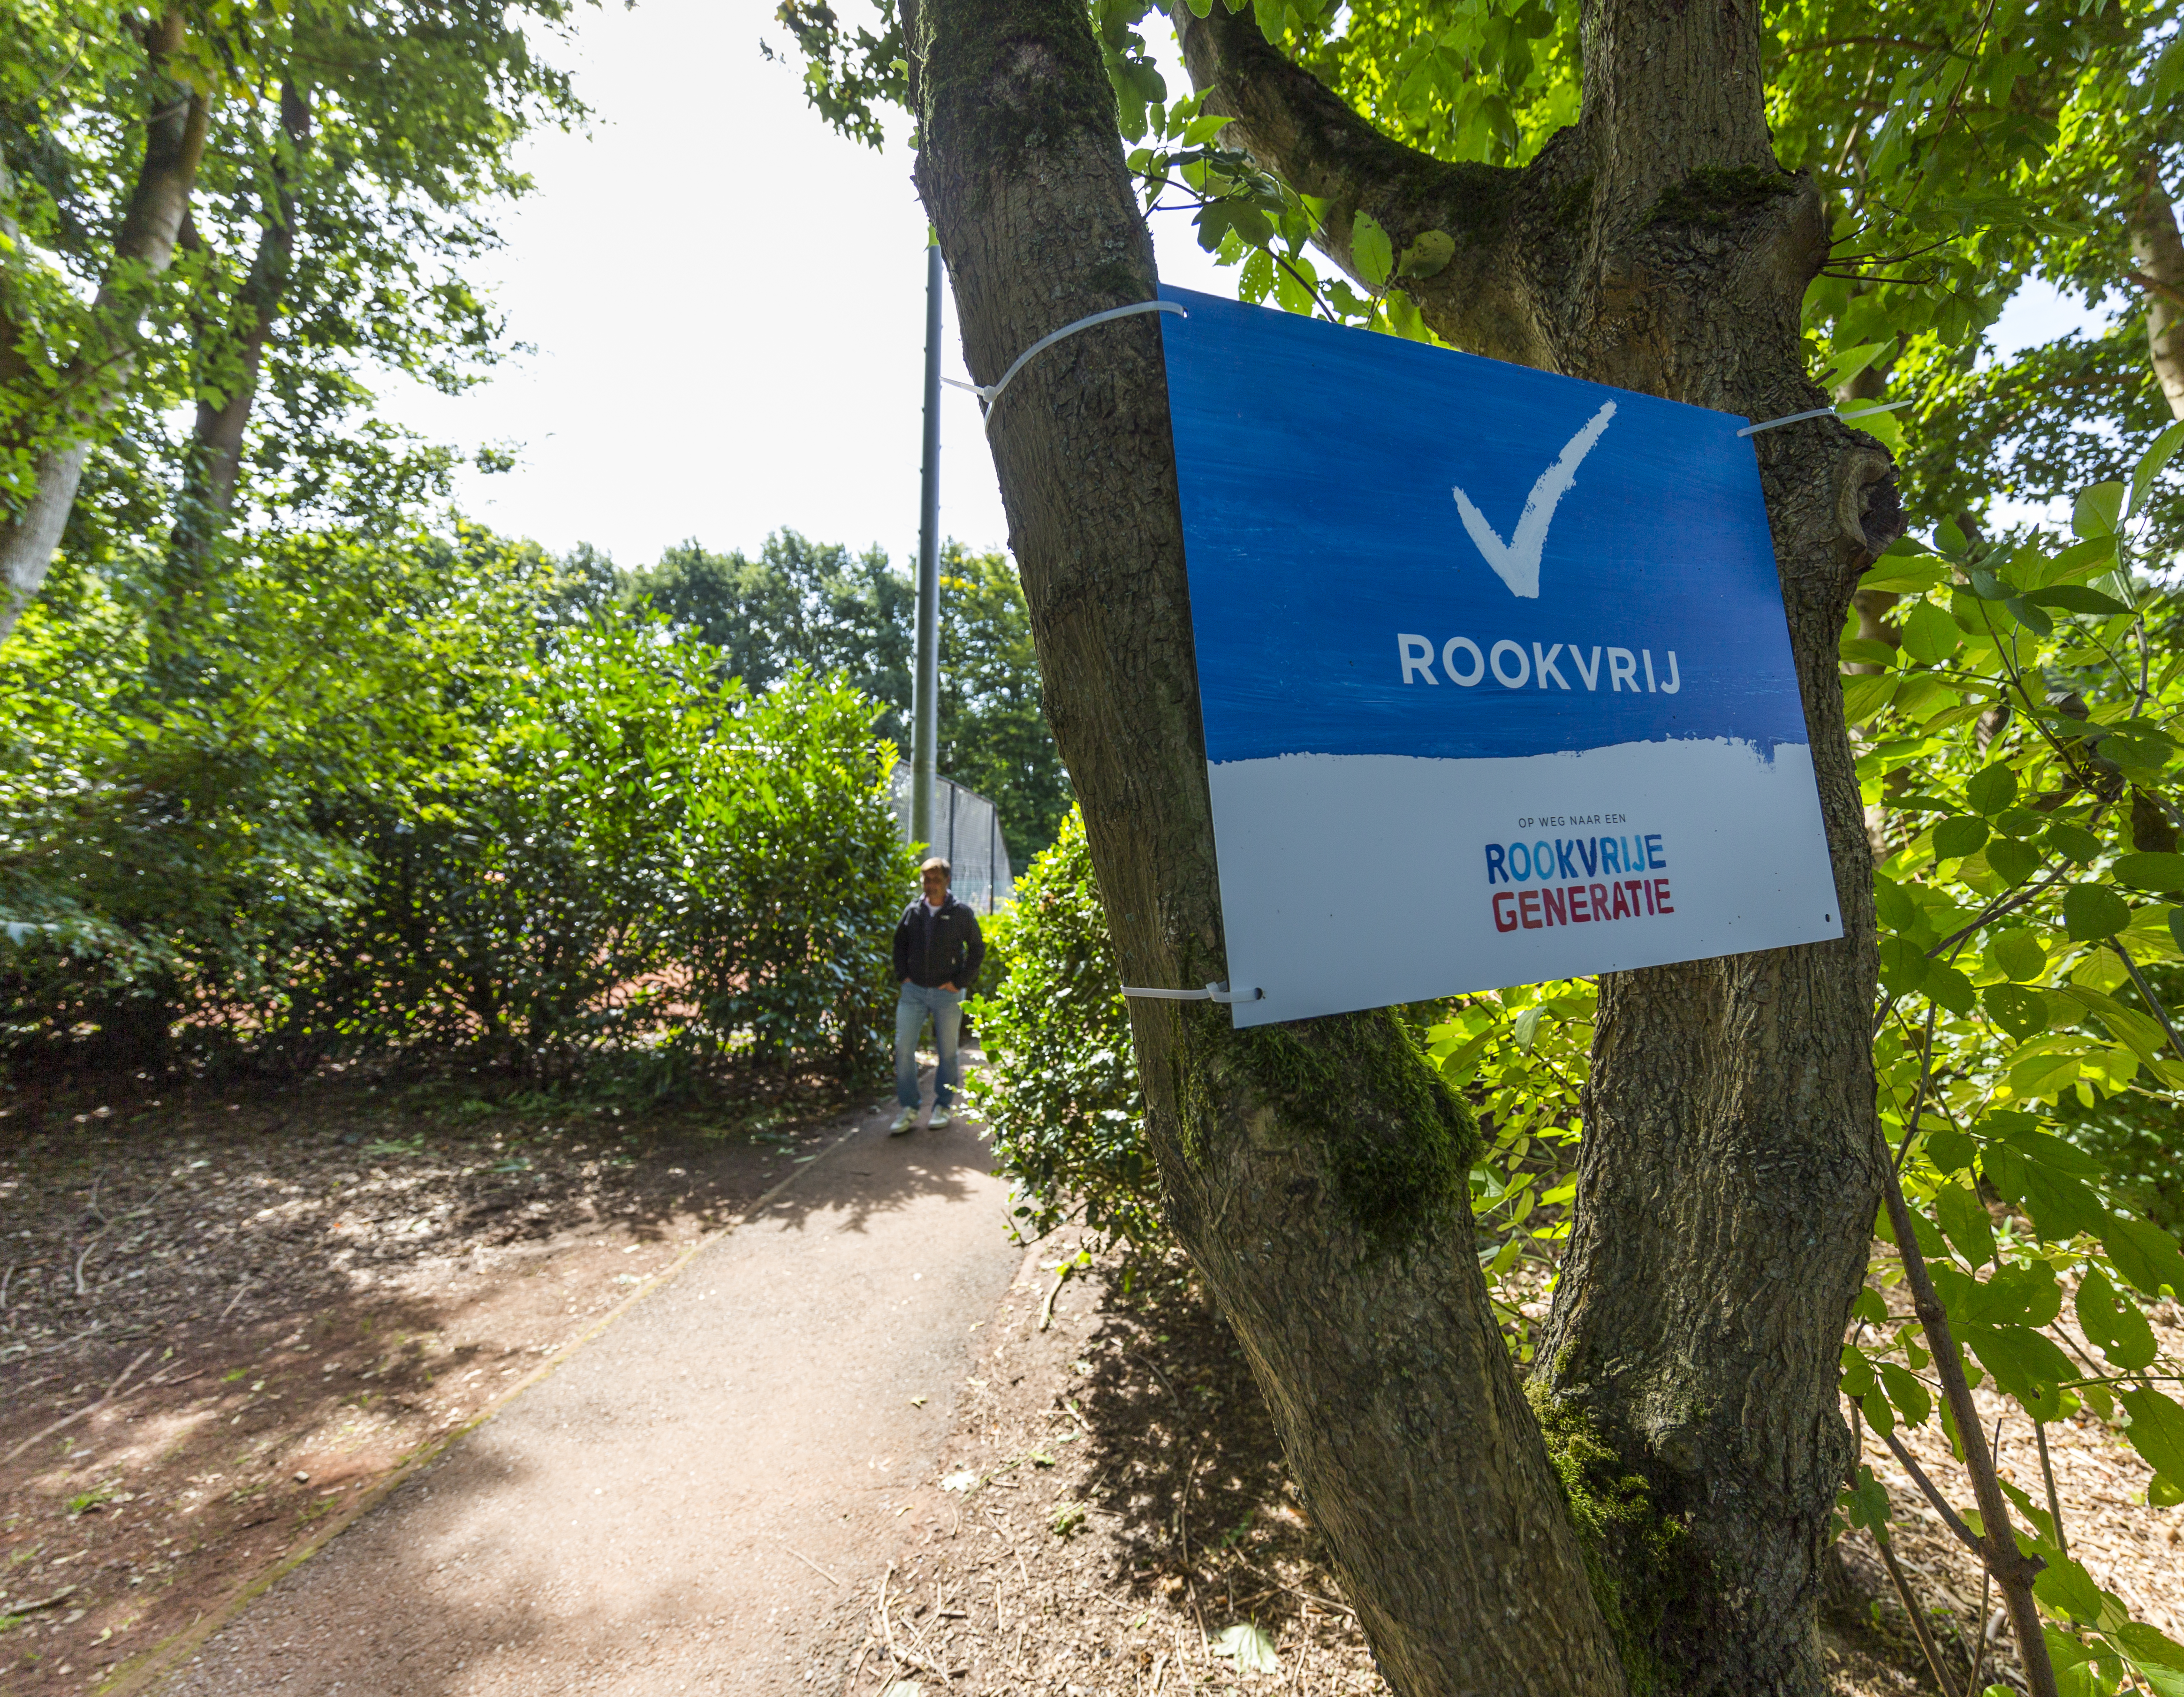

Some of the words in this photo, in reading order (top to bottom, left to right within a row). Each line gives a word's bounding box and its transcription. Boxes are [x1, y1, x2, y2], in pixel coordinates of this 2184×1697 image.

[1397, 633, 1680, 694] ROOKVRIJ
[1518, 818, 1534, 828] OP
[1539, 817, 1565, 827] WEG
[1570, 815, 1601, 826] NAAR
[1605, 814, 1626, 824] EEN
[1485, 834, 1667, 884] ROOKVRIJE
[1492, 879, 1675, 932] GENERATIE
